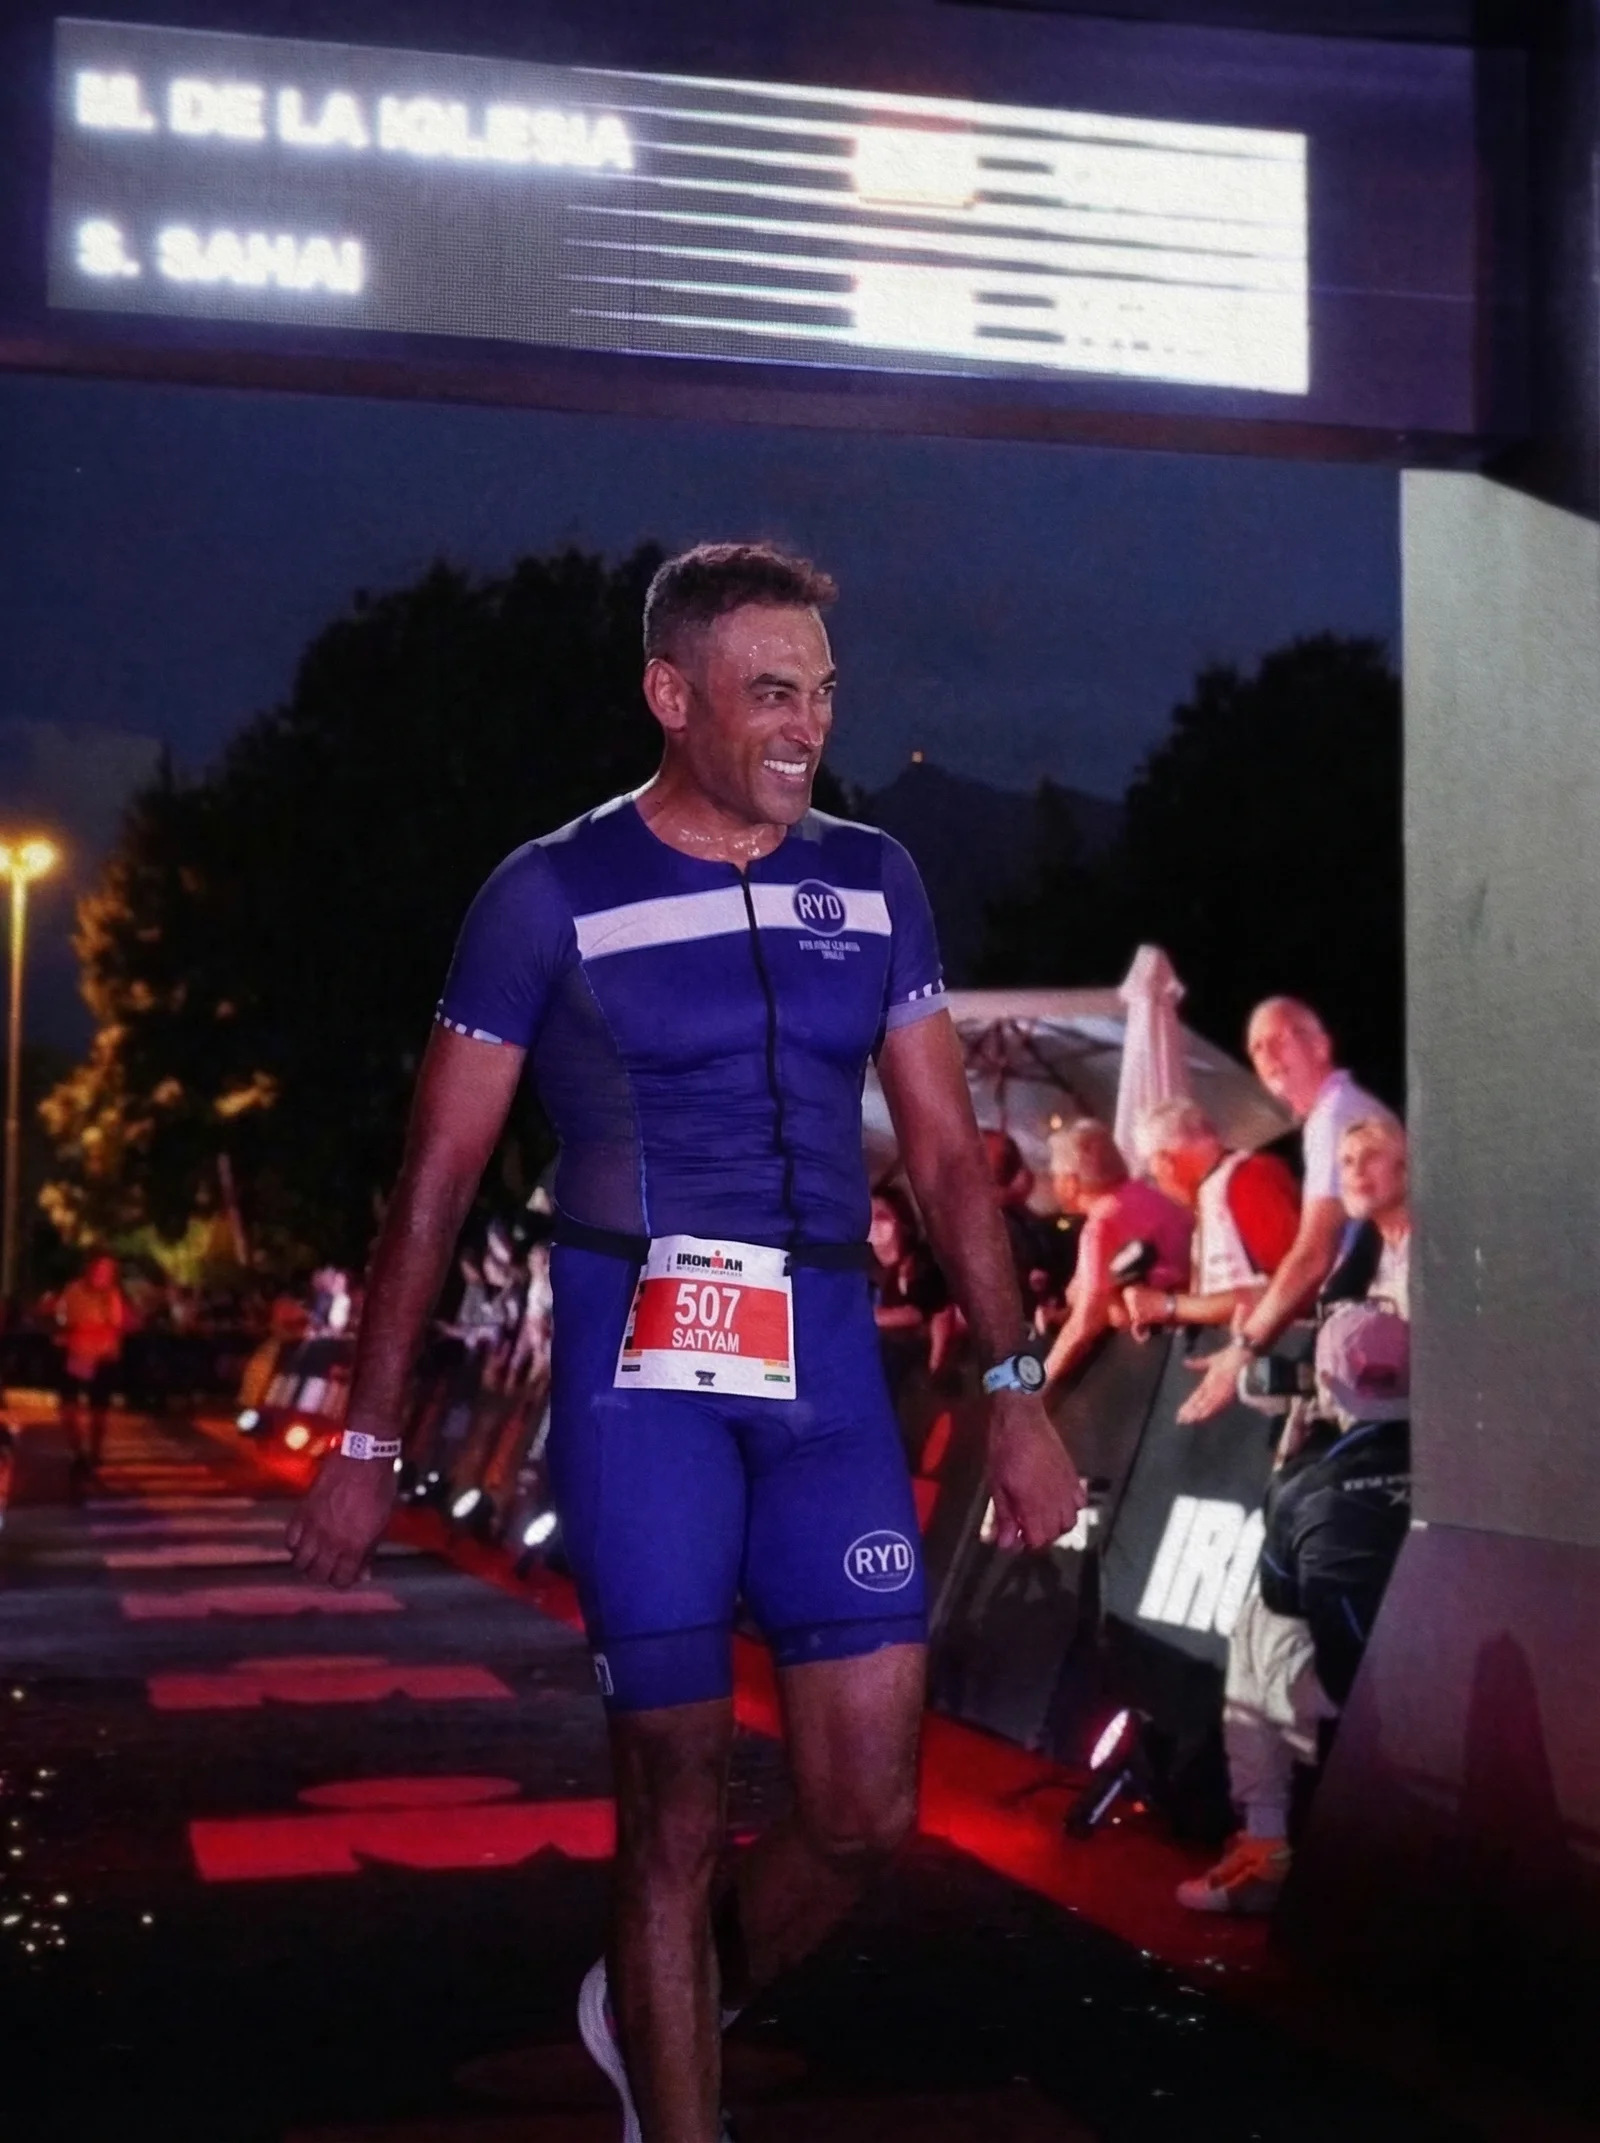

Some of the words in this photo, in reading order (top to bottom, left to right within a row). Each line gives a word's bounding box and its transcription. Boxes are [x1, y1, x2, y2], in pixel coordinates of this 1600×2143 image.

[170, 80, 265, 140] DE
[278, 89, 369, 148] LA
[379, 96, 635, 170] IGLESIA
[78, 221, 140, 276] S.
[797, 892, 842, 920] RYD
[676, 1249, 743, 1272] IRONMAN
[674, 1282, 742, 1330] 507
[671, 1328, 740, 1354] SATYAM
[854, 1542, 910, 1575] RYD
